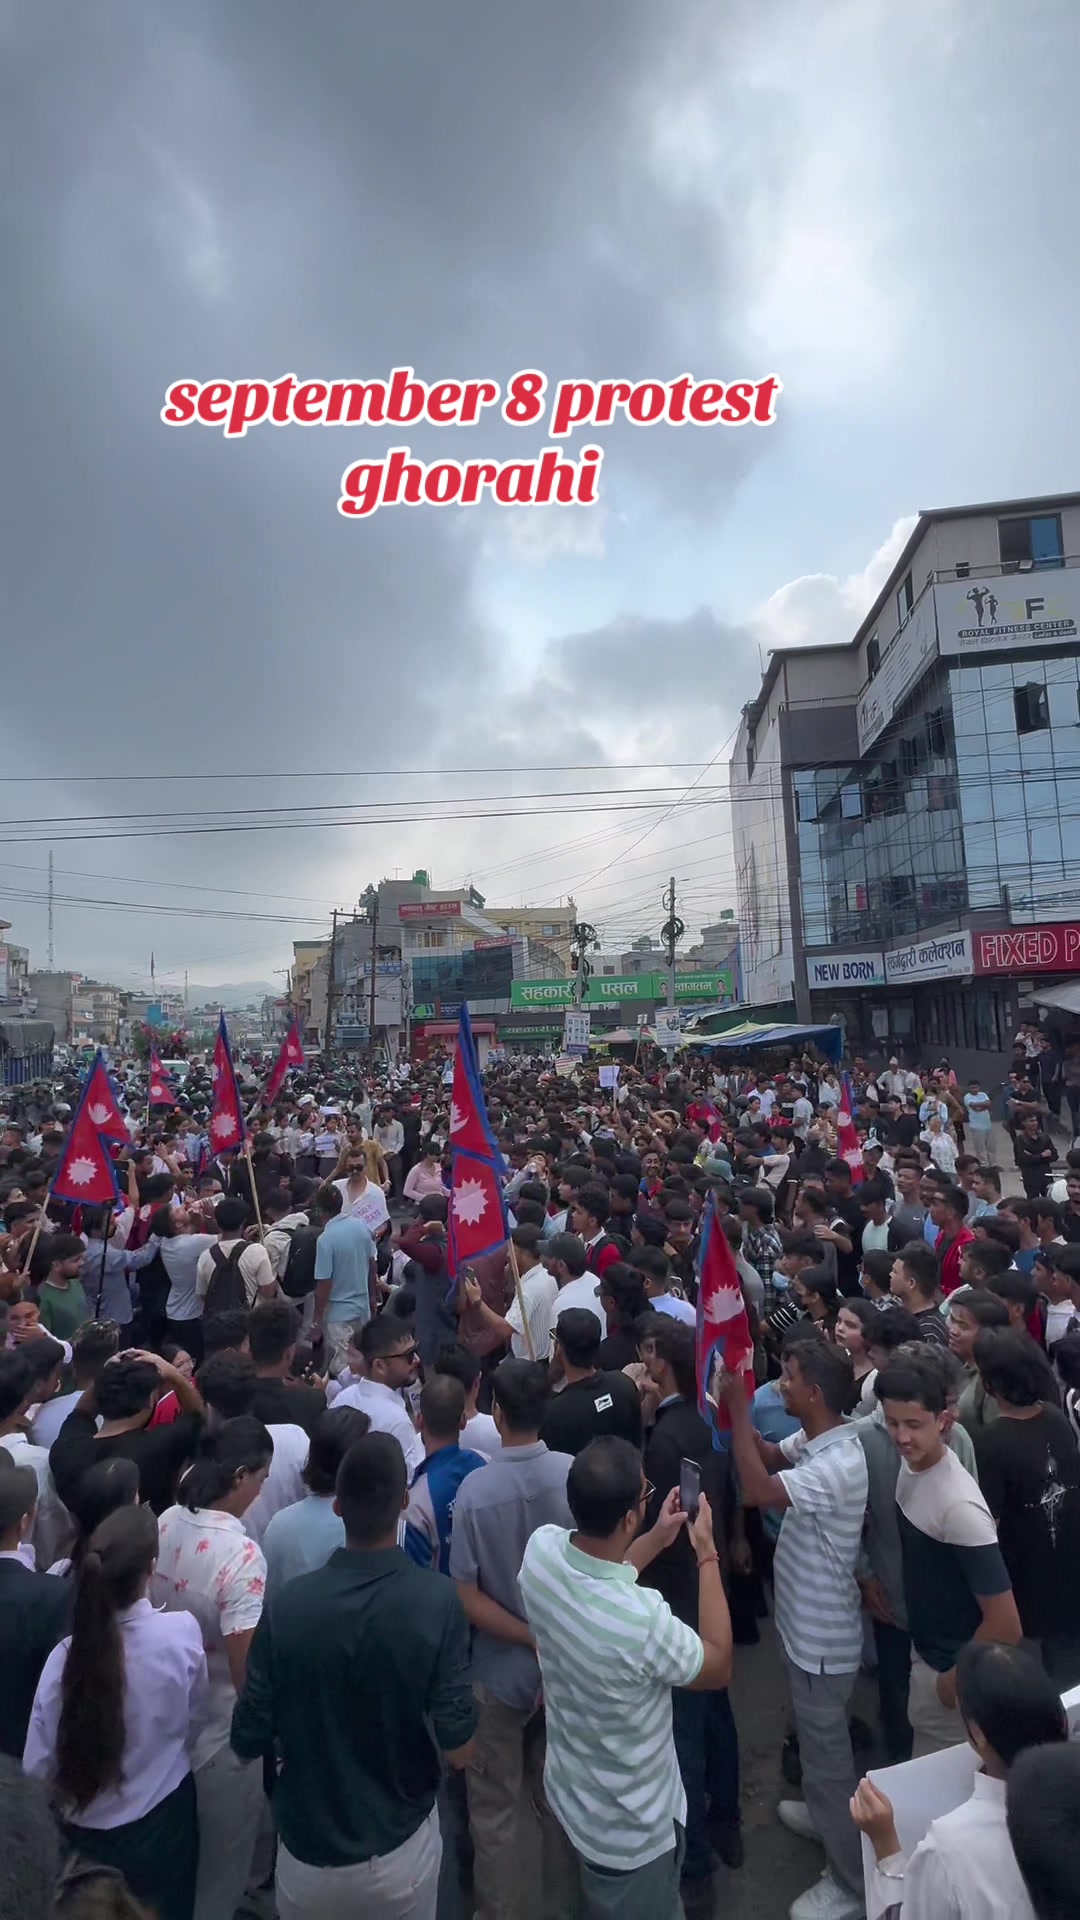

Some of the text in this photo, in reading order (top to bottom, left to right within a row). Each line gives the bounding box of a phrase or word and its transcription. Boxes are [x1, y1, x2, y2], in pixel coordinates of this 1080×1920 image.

[961, 619, 1070, 638] ROYAL FITNESS CENTER
[918, 939, 966, 964] कलेक्शन
[980, 930, 1057, 968] FIXED
[814, 963, 840, 982] NEW
[842, 961, 875, 980] BORN
[600, 981, 639, 996] पसल
